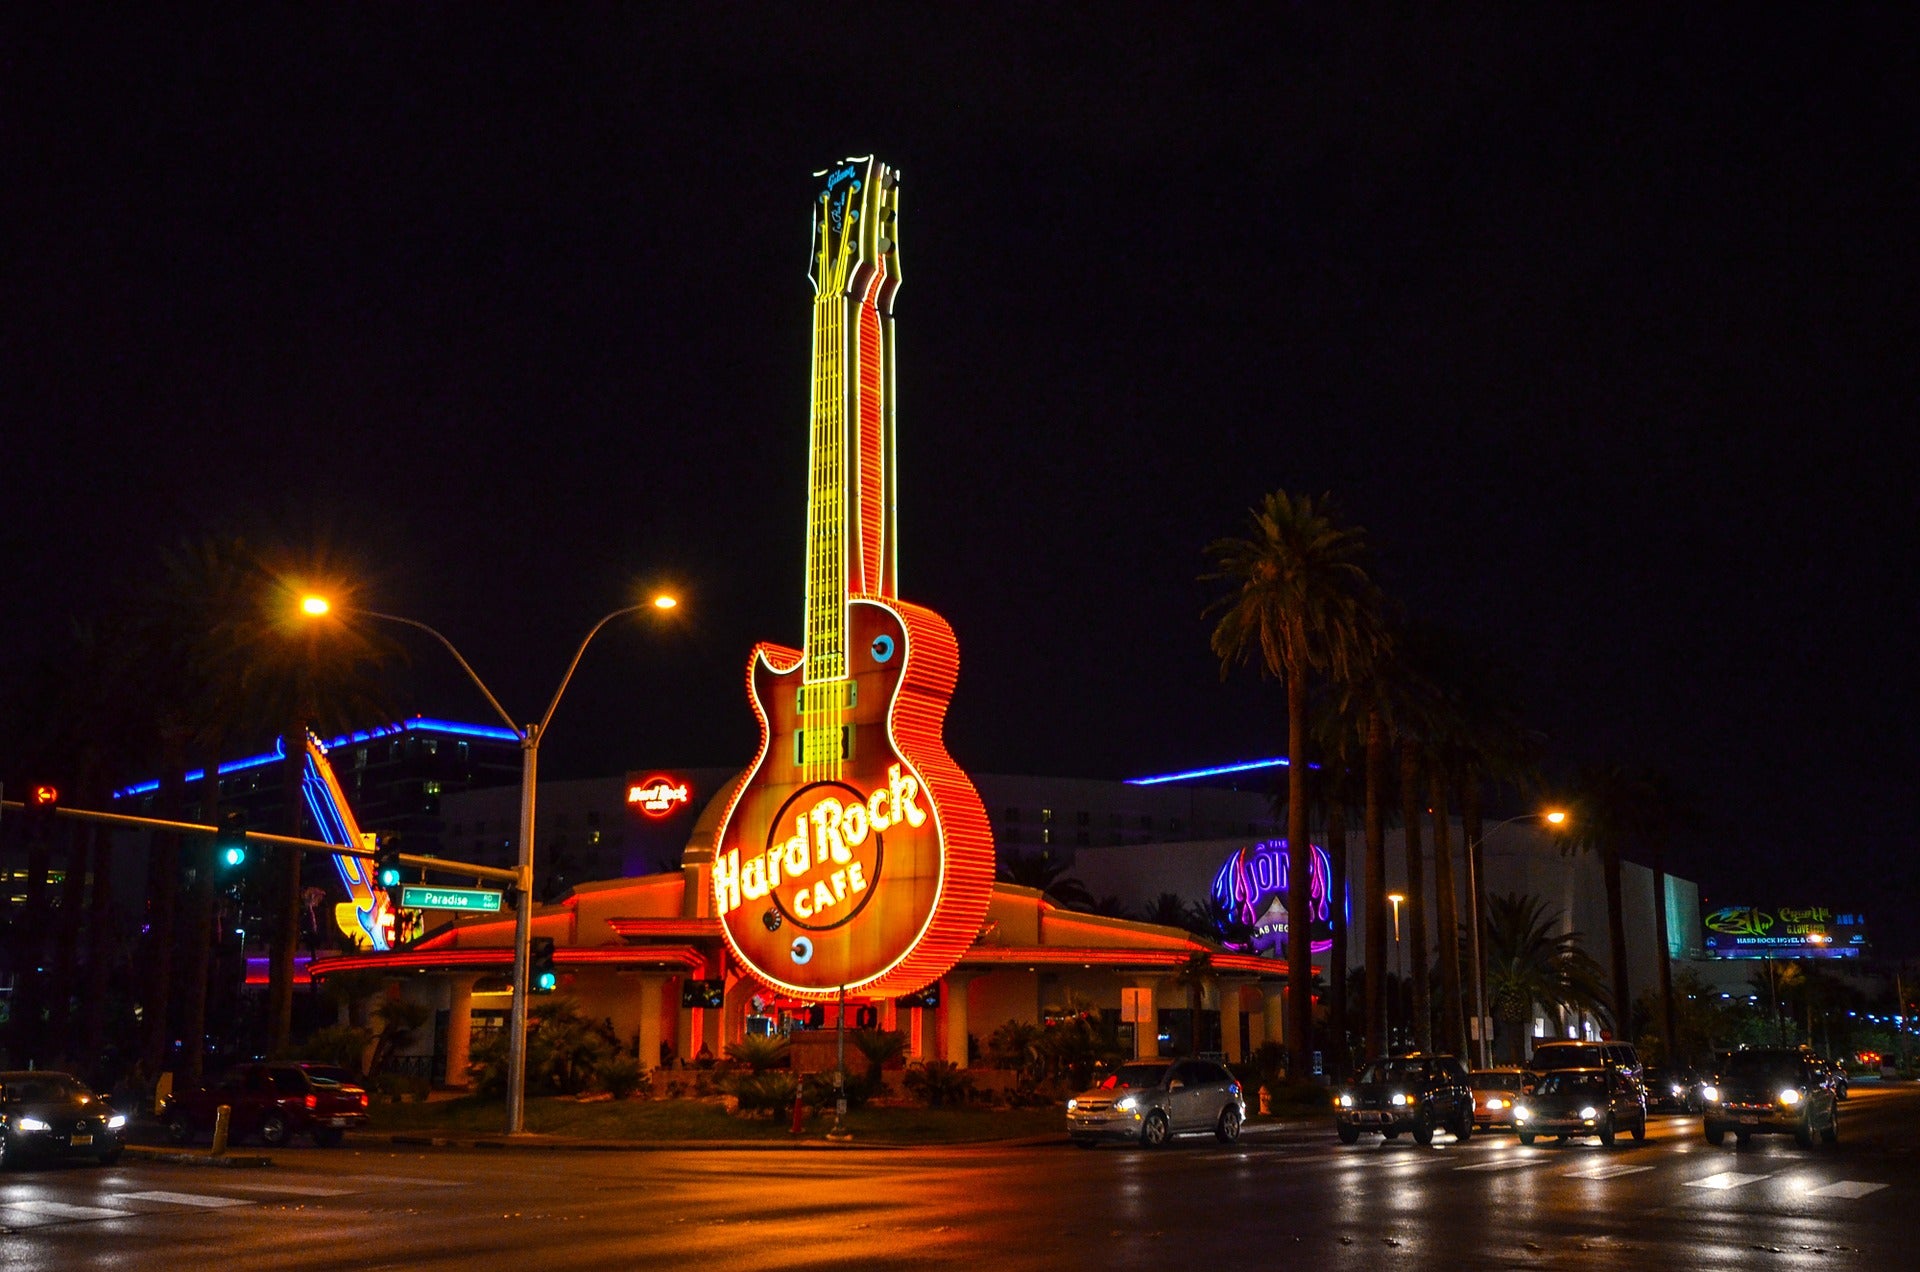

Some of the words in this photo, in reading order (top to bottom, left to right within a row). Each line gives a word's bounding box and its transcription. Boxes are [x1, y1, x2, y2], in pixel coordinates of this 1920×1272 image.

[712, 812, 811, 916] Hard
[809, 763, 927, 865] Rock
[406, 891, 411, 899] S
[424, 892, 468, 906] Paradise
[793, 861, 867, 919] CAFE
